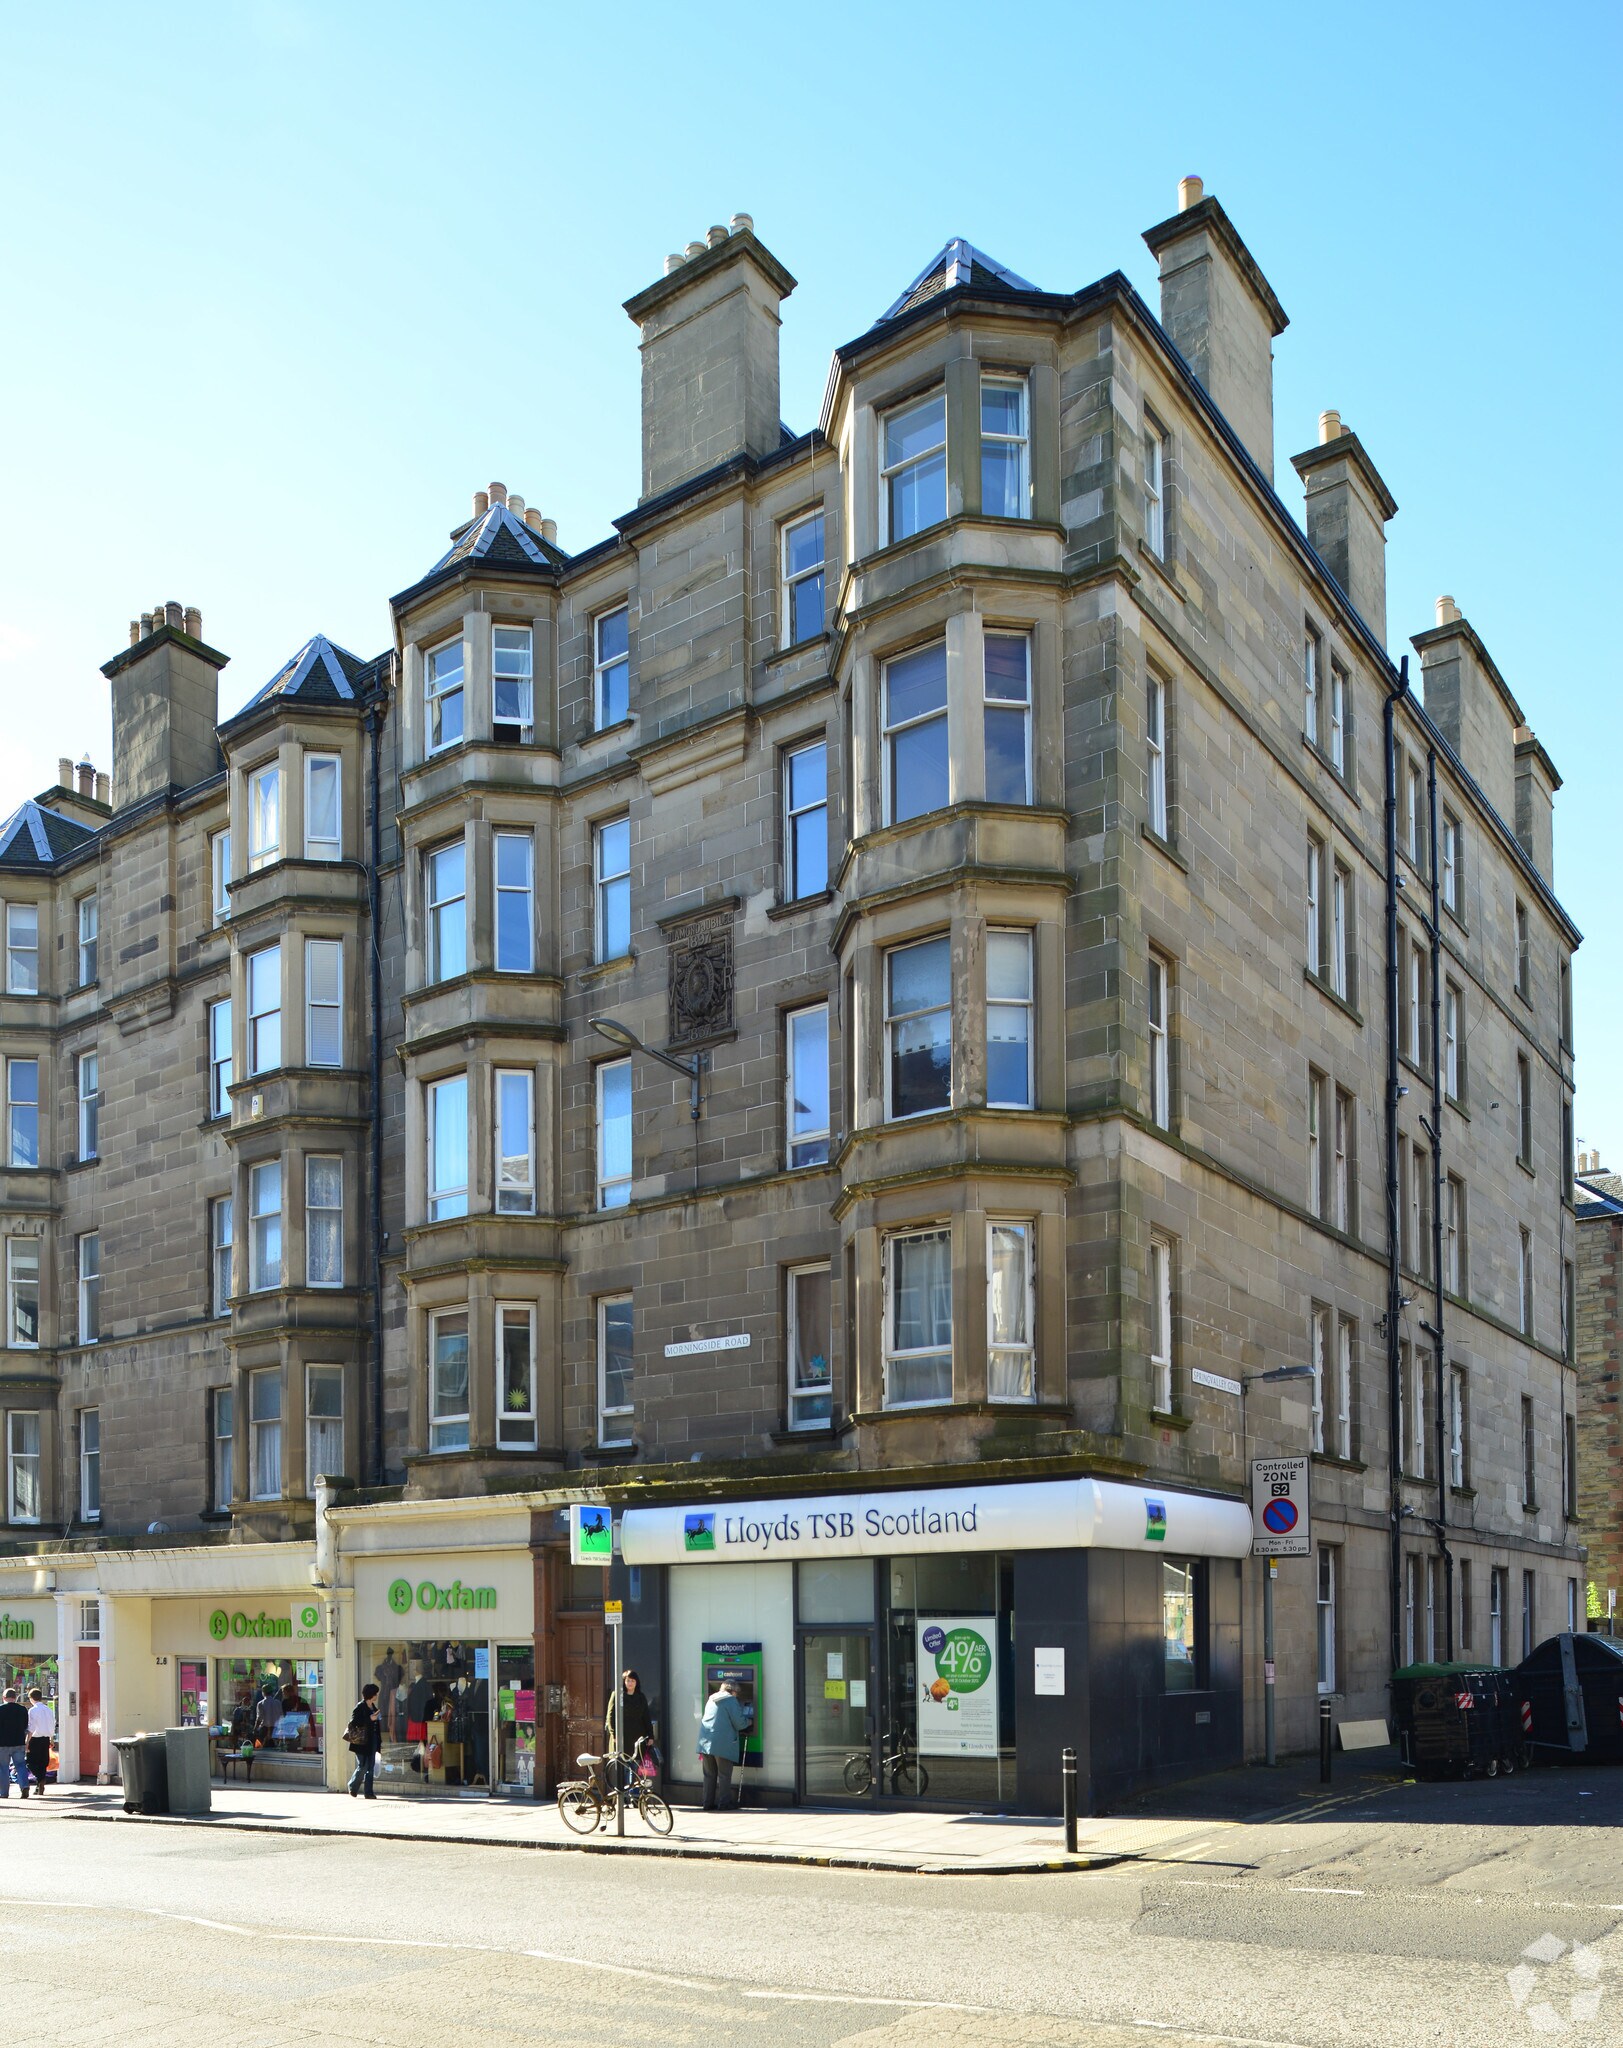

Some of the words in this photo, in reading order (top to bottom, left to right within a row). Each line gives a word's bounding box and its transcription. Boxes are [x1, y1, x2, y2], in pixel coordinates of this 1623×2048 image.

[702, 912, 733, 931] JUBILEE
[688, 931, 712, 949] 1897
[723, 965, 733, 991] R
[666, 1340, 721, 1355] MORNINGSIDE
[725, 1336, 749, 1348] ROAD
[1194, 1370, 1227, 1389] SPRINGVALLEY
[1228, 1381, 1240, 1393] GDNS
[1256, 1461, 1304, 1471] Controlled
[1263, 1471, 1297, 1482] ZONE
[1273, 1484, 1288, 1495] S2
[725, 1514, 799, 1550] Lloyds
[807, 1512, 854, 1539] TSB
[865, 1503, 978, 1537] Scotland
[416, 1580, 497, 1611] Oxfam
[0, 1613, 34, 1640] fam
[231, 1611, 292, 1638] Oxfam
[297, 1630, 324, 1639] Oxfam
[925, 1632, 942, 1642] Limited
[716, 1644, 745, 1652] cashpoint
[929, 1640, 941, 1648] Offer
[974, 1644, 986, 1652] AER
[939, 1641, 982, 1673] 4%
